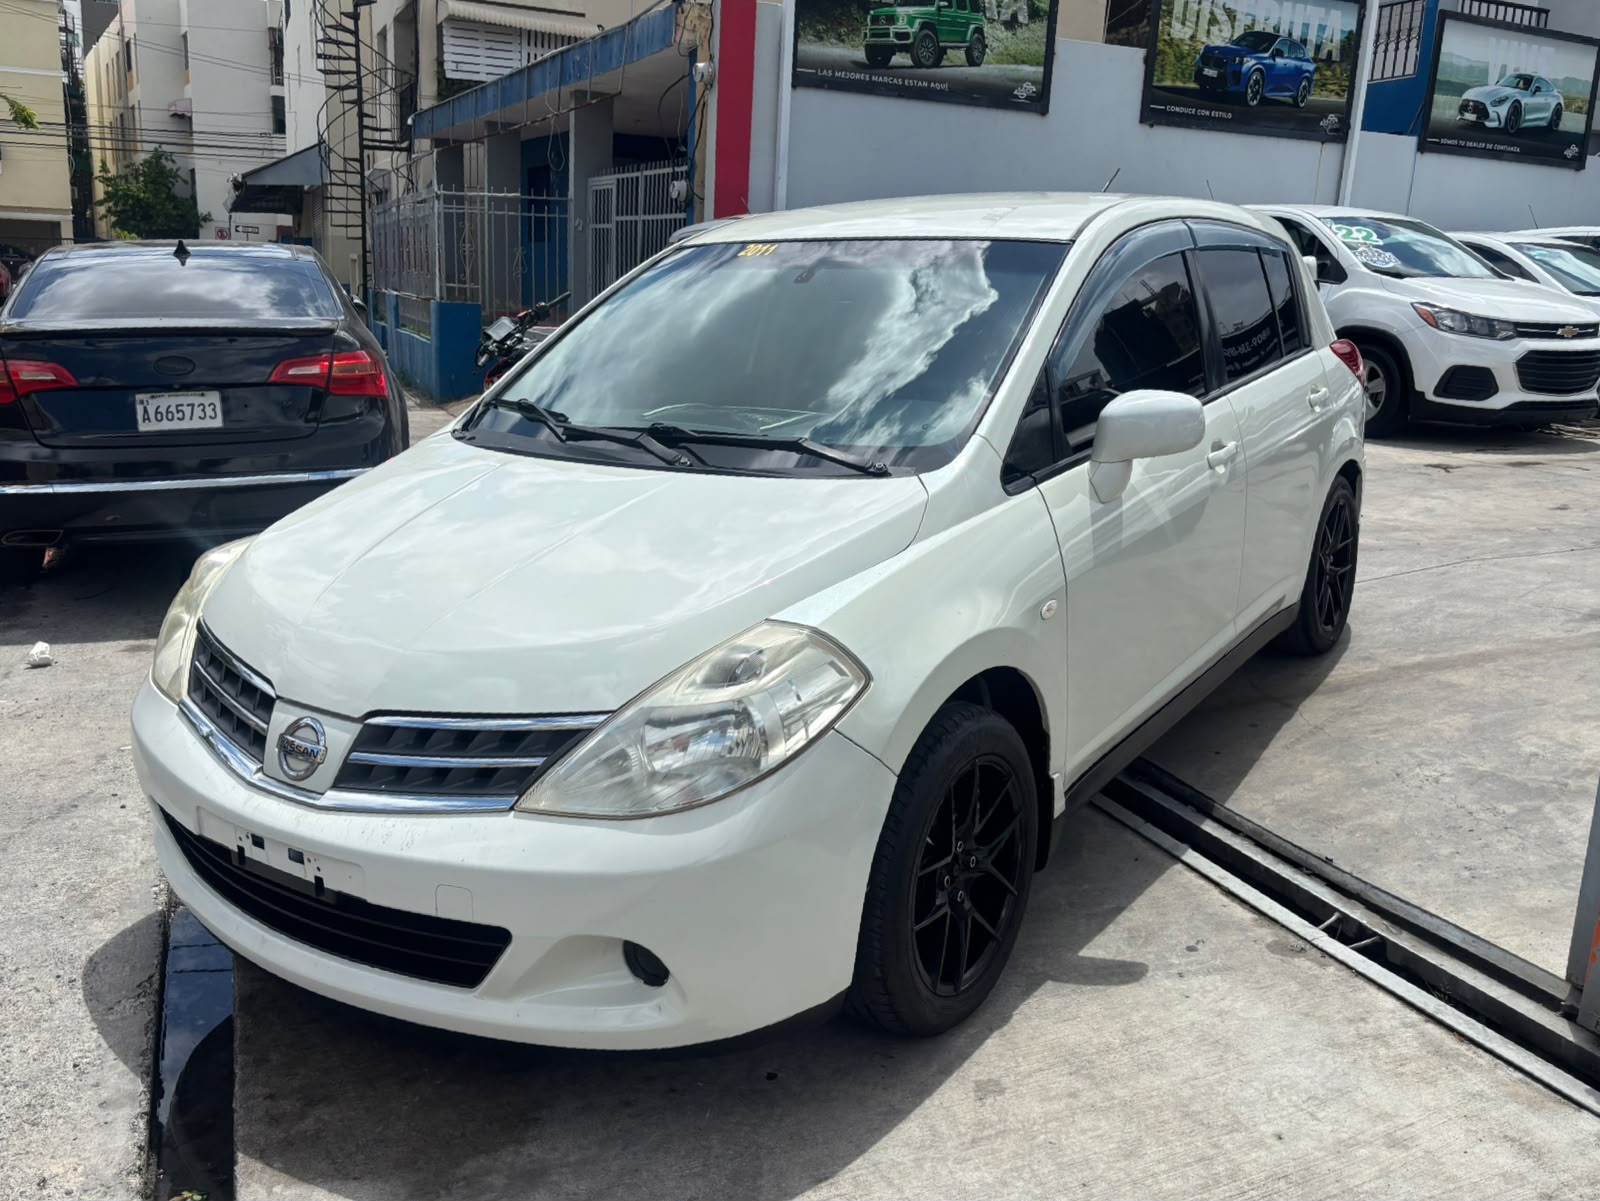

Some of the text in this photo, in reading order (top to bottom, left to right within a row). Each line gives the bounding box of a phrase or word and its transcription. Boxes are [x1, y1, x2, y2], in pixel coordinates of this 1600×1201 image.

[817, 68, 949, 90] LAS MEJORES MARCAS ESTAN AQUÍ
[1166, 105, 1233, 119] CONDUCE CON ESTILO
[1493, 144, 1520, 152] CONFIANZA
[1333, 225, 1382, 245] 22
[737, 243, 779, 256] 2011
[142, 402, 218, 424] A665733
[279, 737, 320, 759] NISSAN
